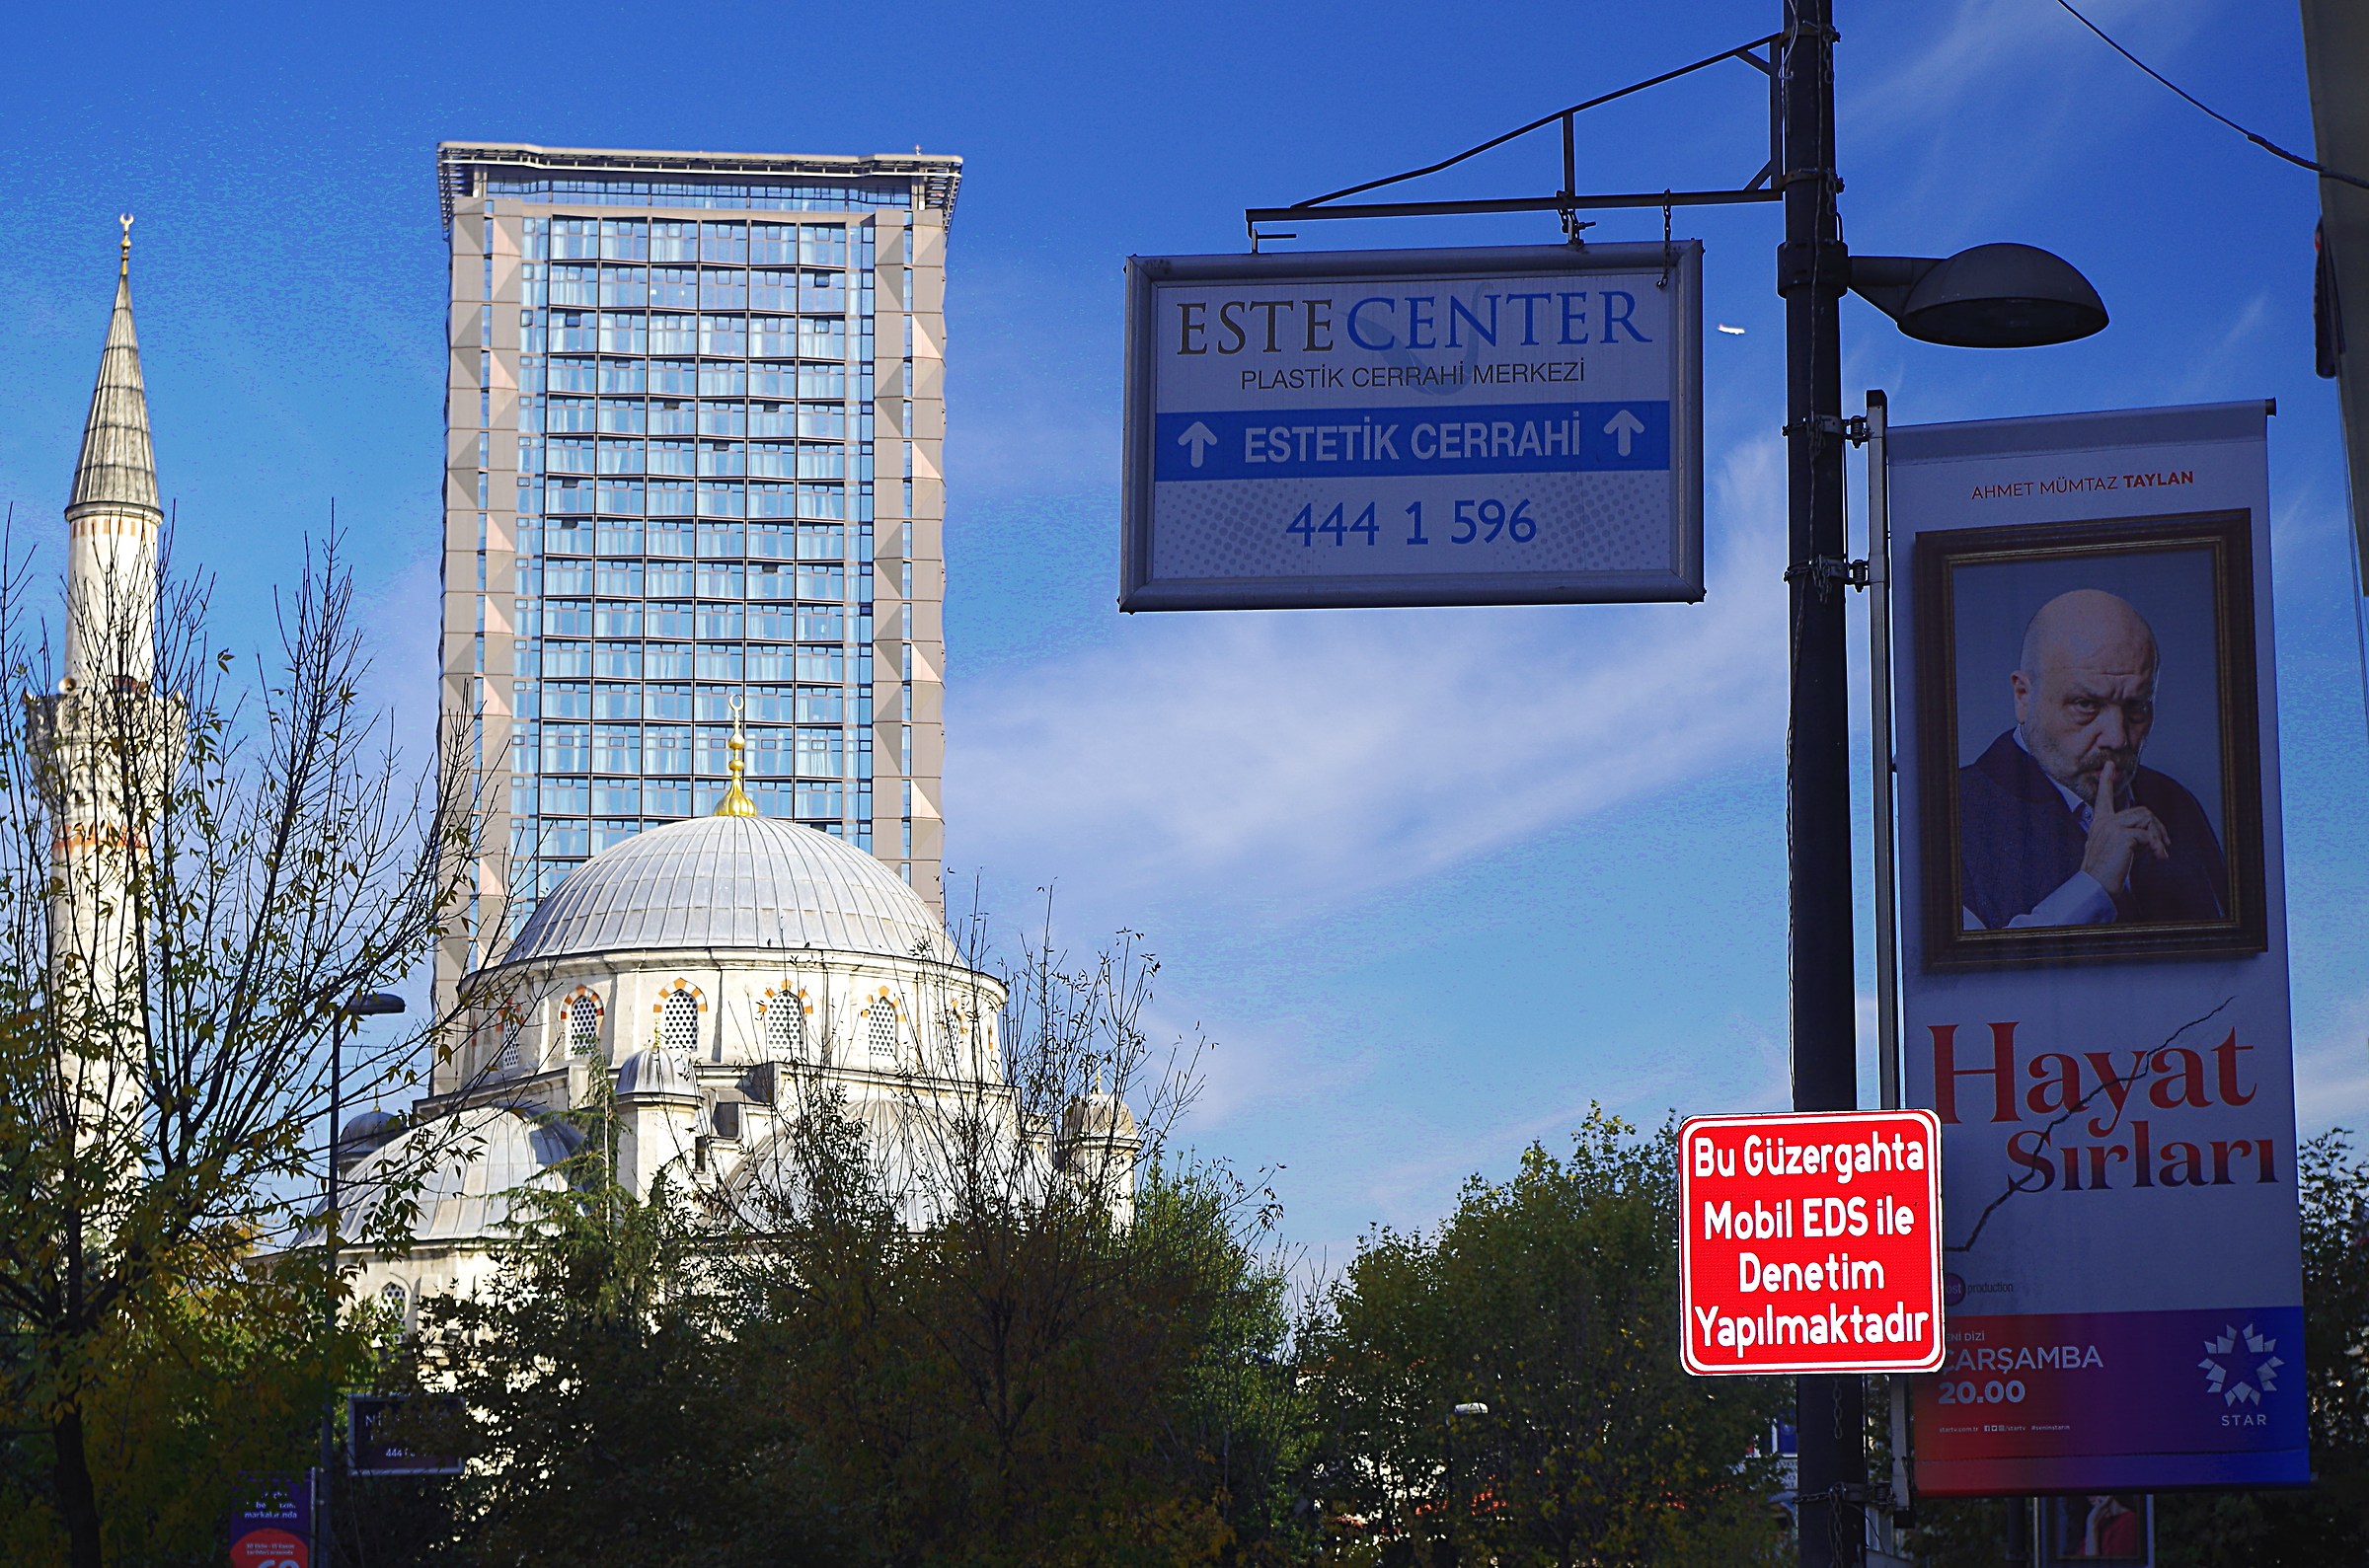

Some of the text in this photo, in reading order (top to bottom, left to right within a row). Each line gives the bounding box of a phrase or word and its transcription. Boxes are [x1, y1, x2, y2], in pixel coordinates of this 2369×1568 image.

[1241, 359, 1585, 391] PLASTİK CERRAHİ MERKEZİ
[1244, 411, 1580, 465] ESTETİK CERRAHİ
[1971, 470, 2194, 500] AHMET MÜMTAZ TAYLAN
[1285, 498, 1538, 547] 444 1 596
[1928, 1021, 2257, 1138] Hayat
[1694, 1130, 1924, 1184] Bu Güzergahta
[2006, 1120, 2280, 1194] Sırları
[1704, 1195, 1916, 1240] Mobil EDS ile
[1738, 1251, 1884, 1293] Denetim
[1945, 1281, 2014, 1296] ost production
[1694, 1301, 1930, 1359] Yapılmaktadır
[1946, 1329, 1985, 1342] ENİ DİZİ
[1938, 1380, 2026, 1405] 20.00
[2221, 1413, 2267, 1427] STAR
